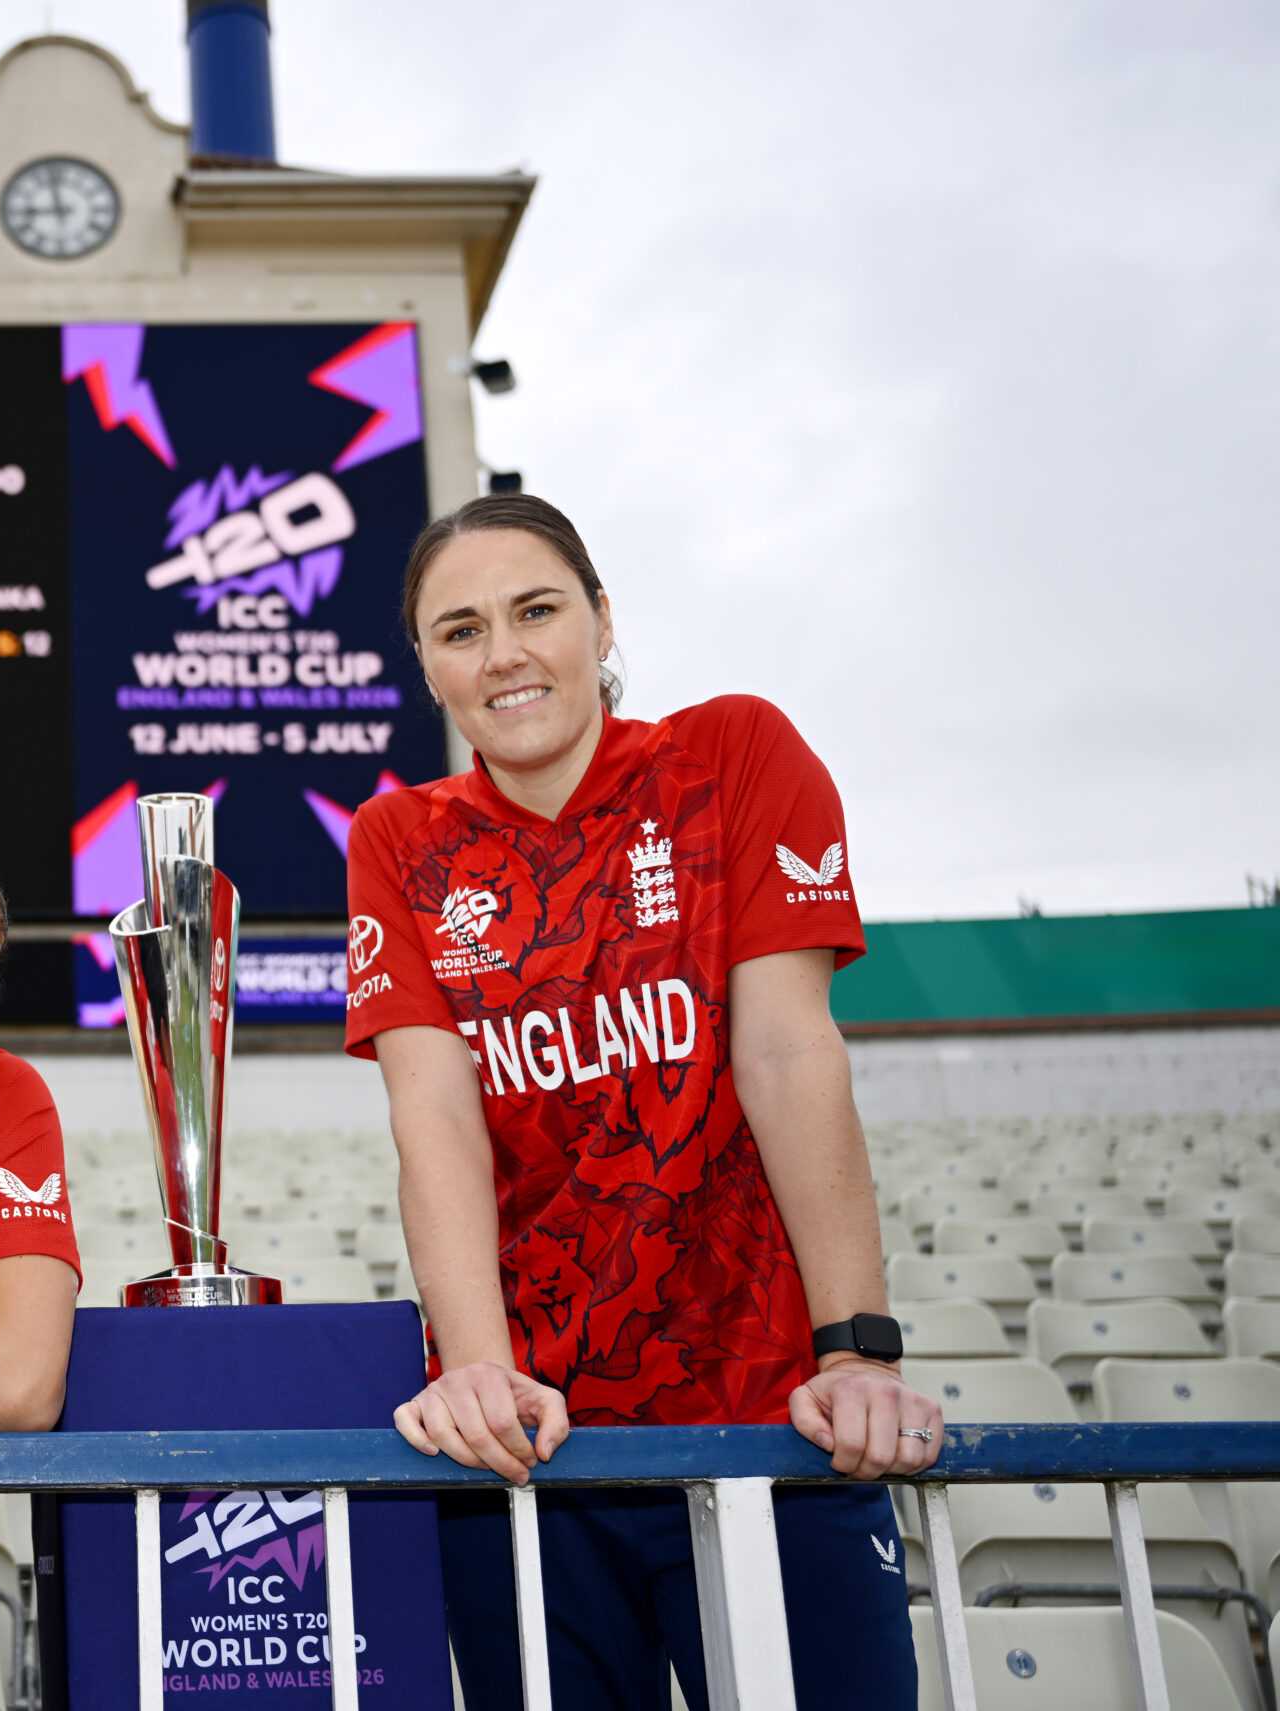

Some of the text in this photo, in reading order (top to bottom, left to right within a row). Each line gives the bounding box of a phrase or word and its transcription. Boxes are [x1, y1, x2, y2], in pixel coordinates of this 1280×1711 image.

[145, 472, 356, 590] T20
[217, 594, 290, 629] ICC
[22, 630, 52, 657] 12
[132, 651, 384, 687] WORLD CUP
[129, 723, 167, 754] 12
[168, 723, 262, 754] JUNE
[282, 723, 306, 754] 5
[309, 722, 394, 754] JULY
[786, 890, 850, 903] CASTORE
[435, 890, 498, 935] T20
[457, 932, 475, 947] ICC
[430, 950, 503, 971] WORLD CUP
[435, 969, 463, 979] GLAND
[1, 1206, 67, 1224] CASTORE
[203, 1291, 223, 1300] CUP
[227, 1575, 286, 1605] ICC
[190, 1612, 328, 1633] WOMEN'S T20
[162, 1636, 287, 1669] WORLD
[163, 1668, 384, 1692] GLAND & WALES 26
